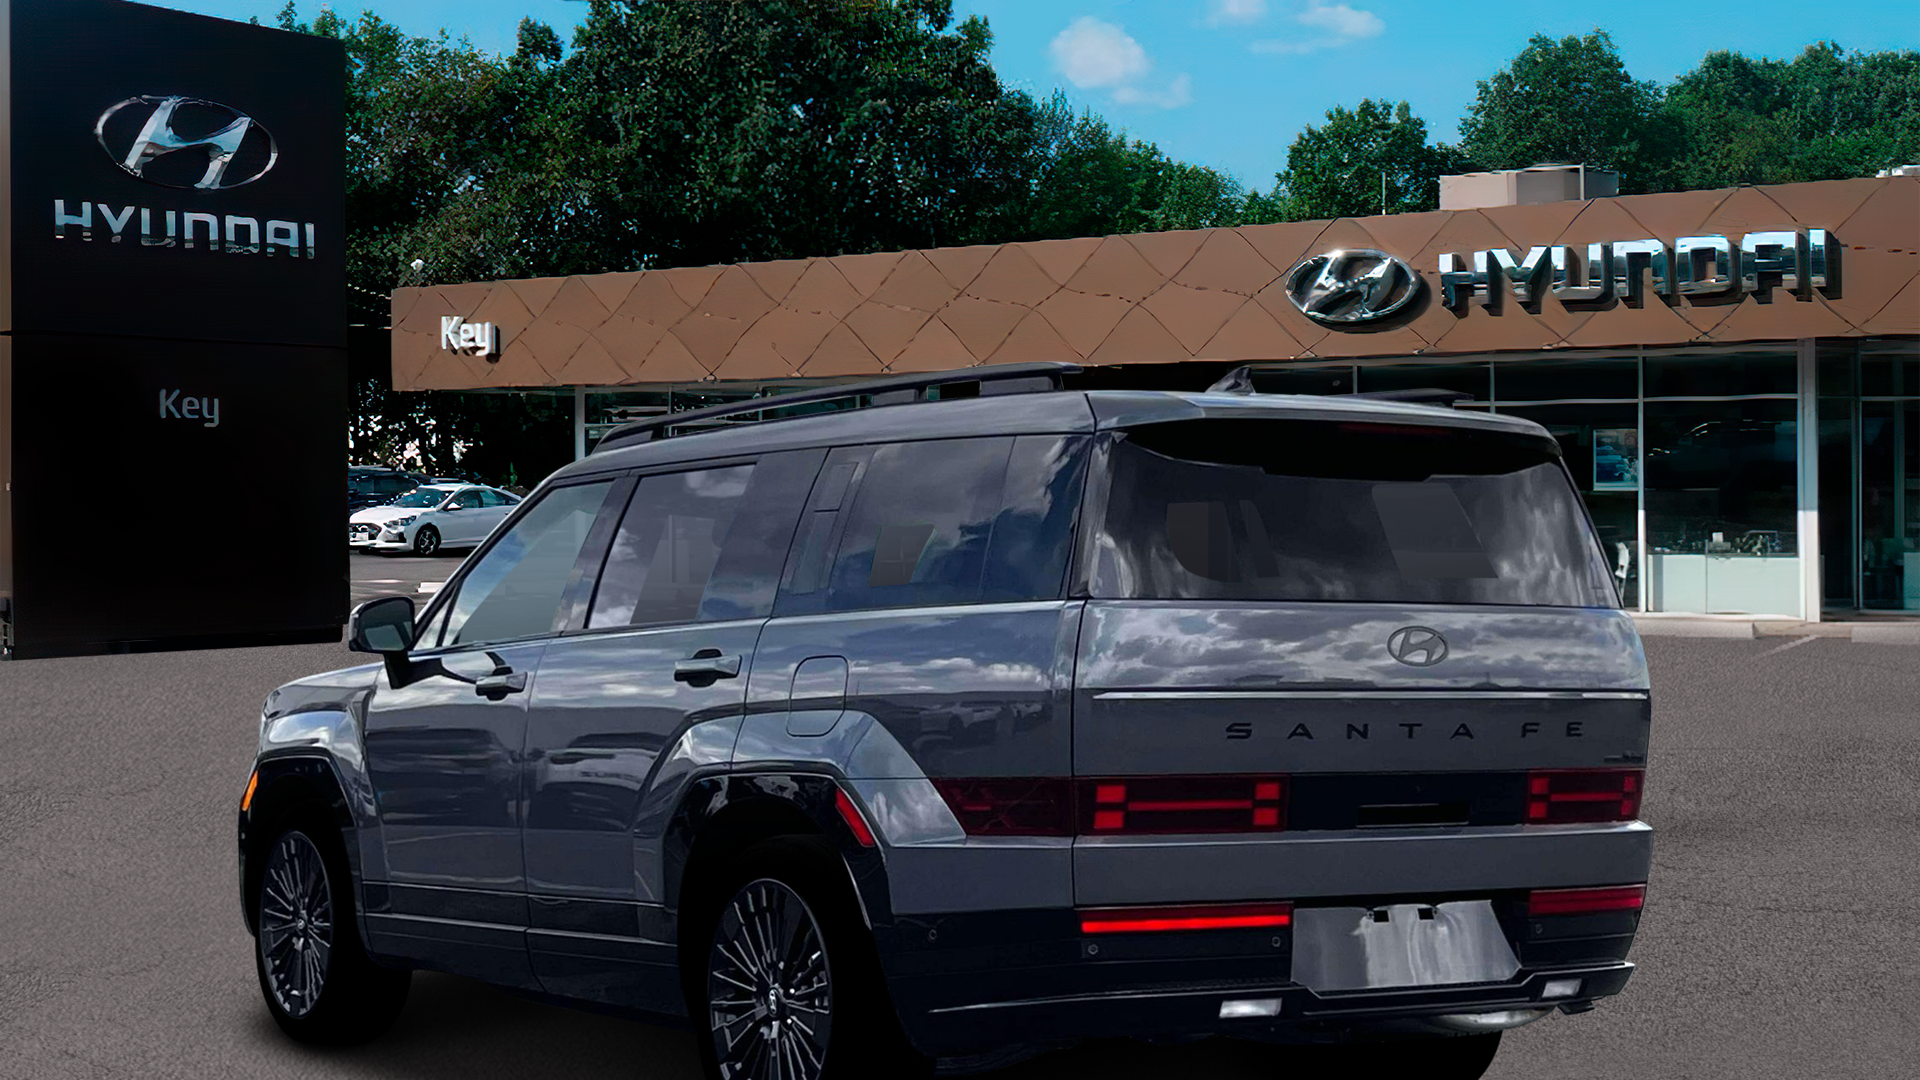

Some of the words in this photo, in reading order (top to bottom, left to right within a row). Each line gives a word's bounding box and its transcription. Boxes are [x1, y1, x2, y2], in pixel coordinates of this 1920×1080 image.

[54, 199, 315, 260] HYUNDAI
[1438, 228, 1830, 310] HYUNDAI
[440, 315, 494, 357] Key
[159, 388, 219, 428] Key
[1226, 722, 1474, 740] SANTA
[1521, 721, 1584, 739] FE
